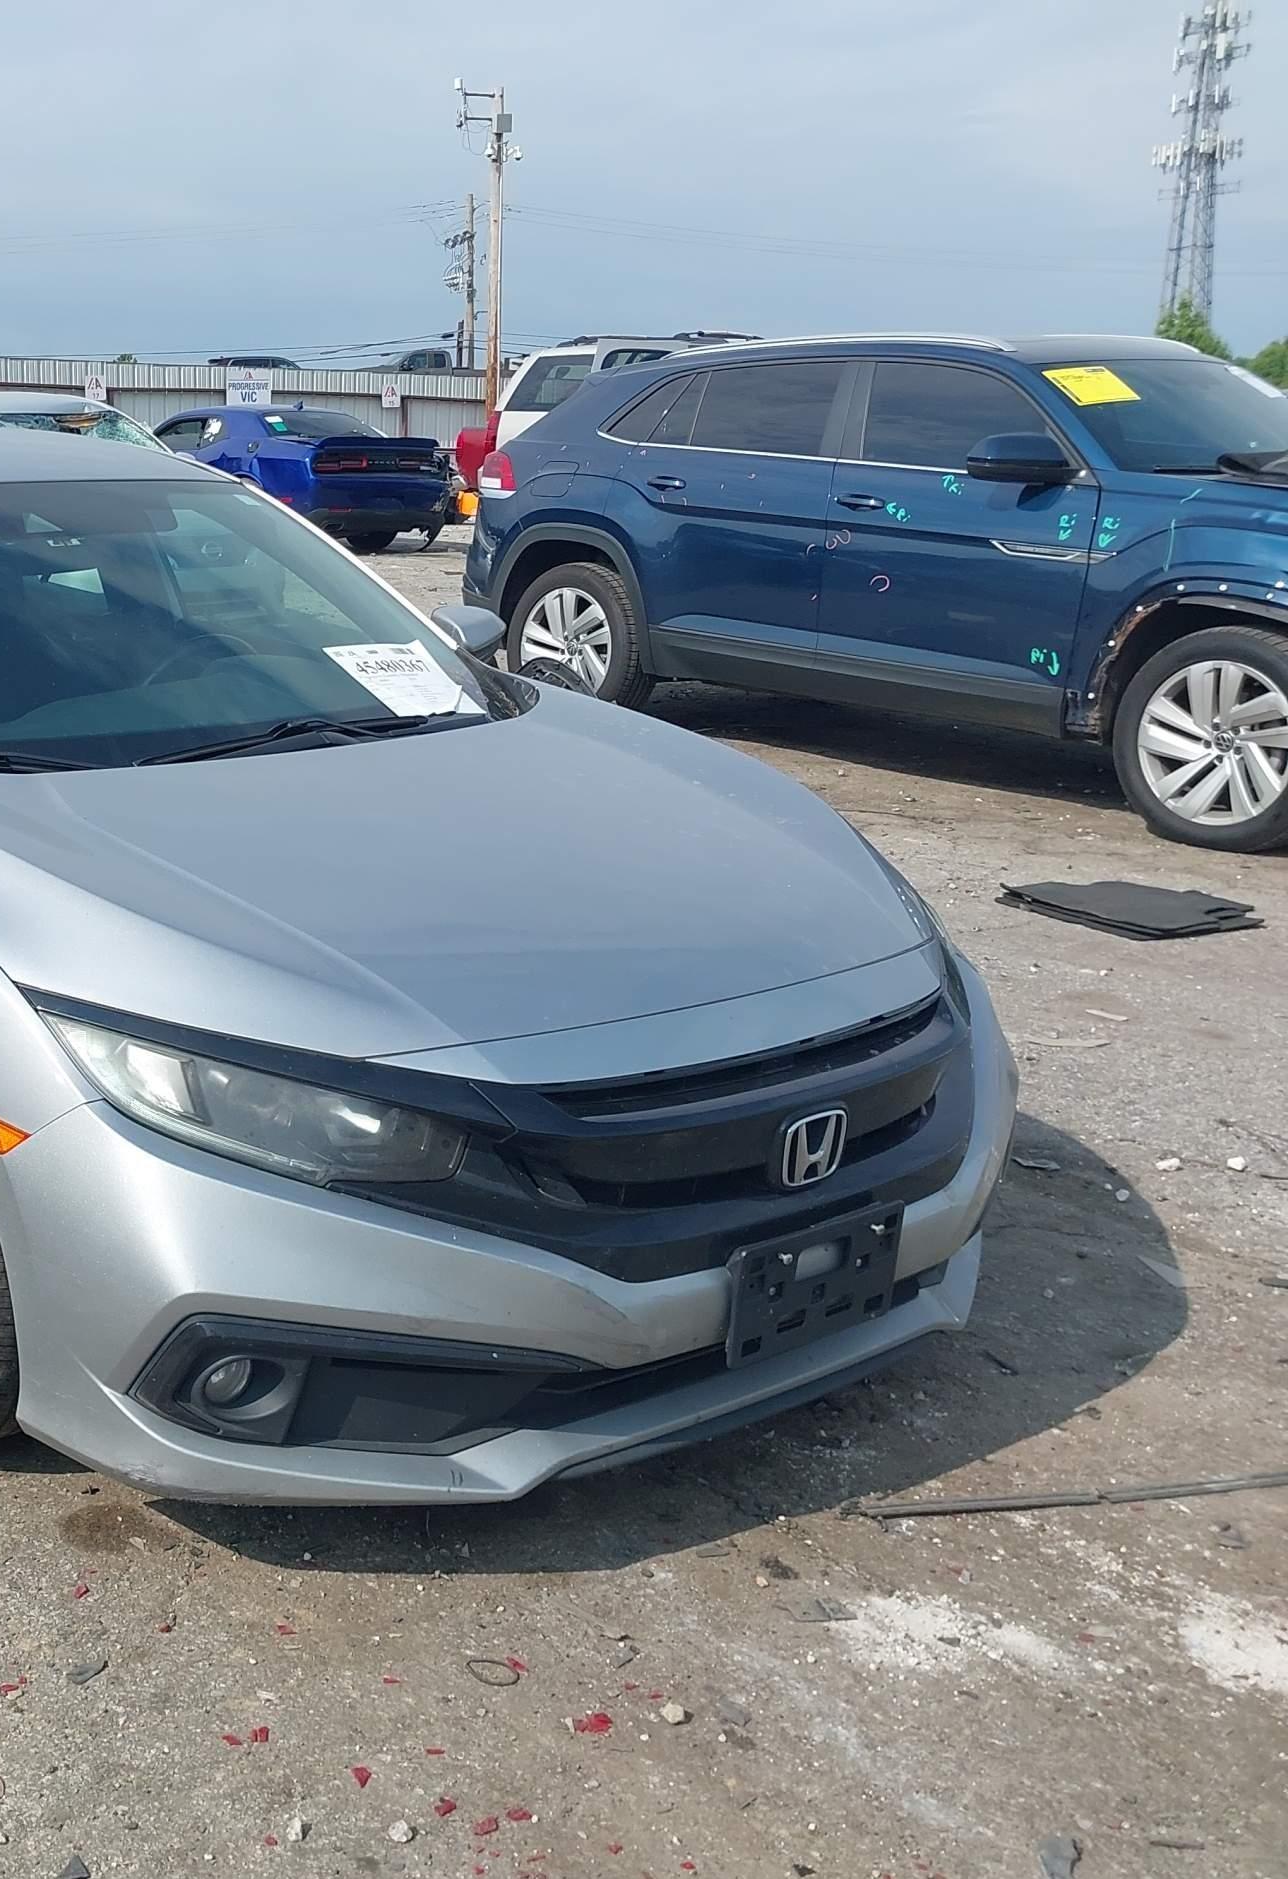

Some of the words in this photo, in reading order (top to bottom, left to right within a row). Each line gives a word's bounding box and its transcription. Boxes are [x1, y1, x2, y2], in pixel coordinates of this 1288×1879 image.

[228, 382, 269, 391] PROGRESSIVE
[241, 391, 258, 403] VIC
[355, 659, 431, 674] 45480367
